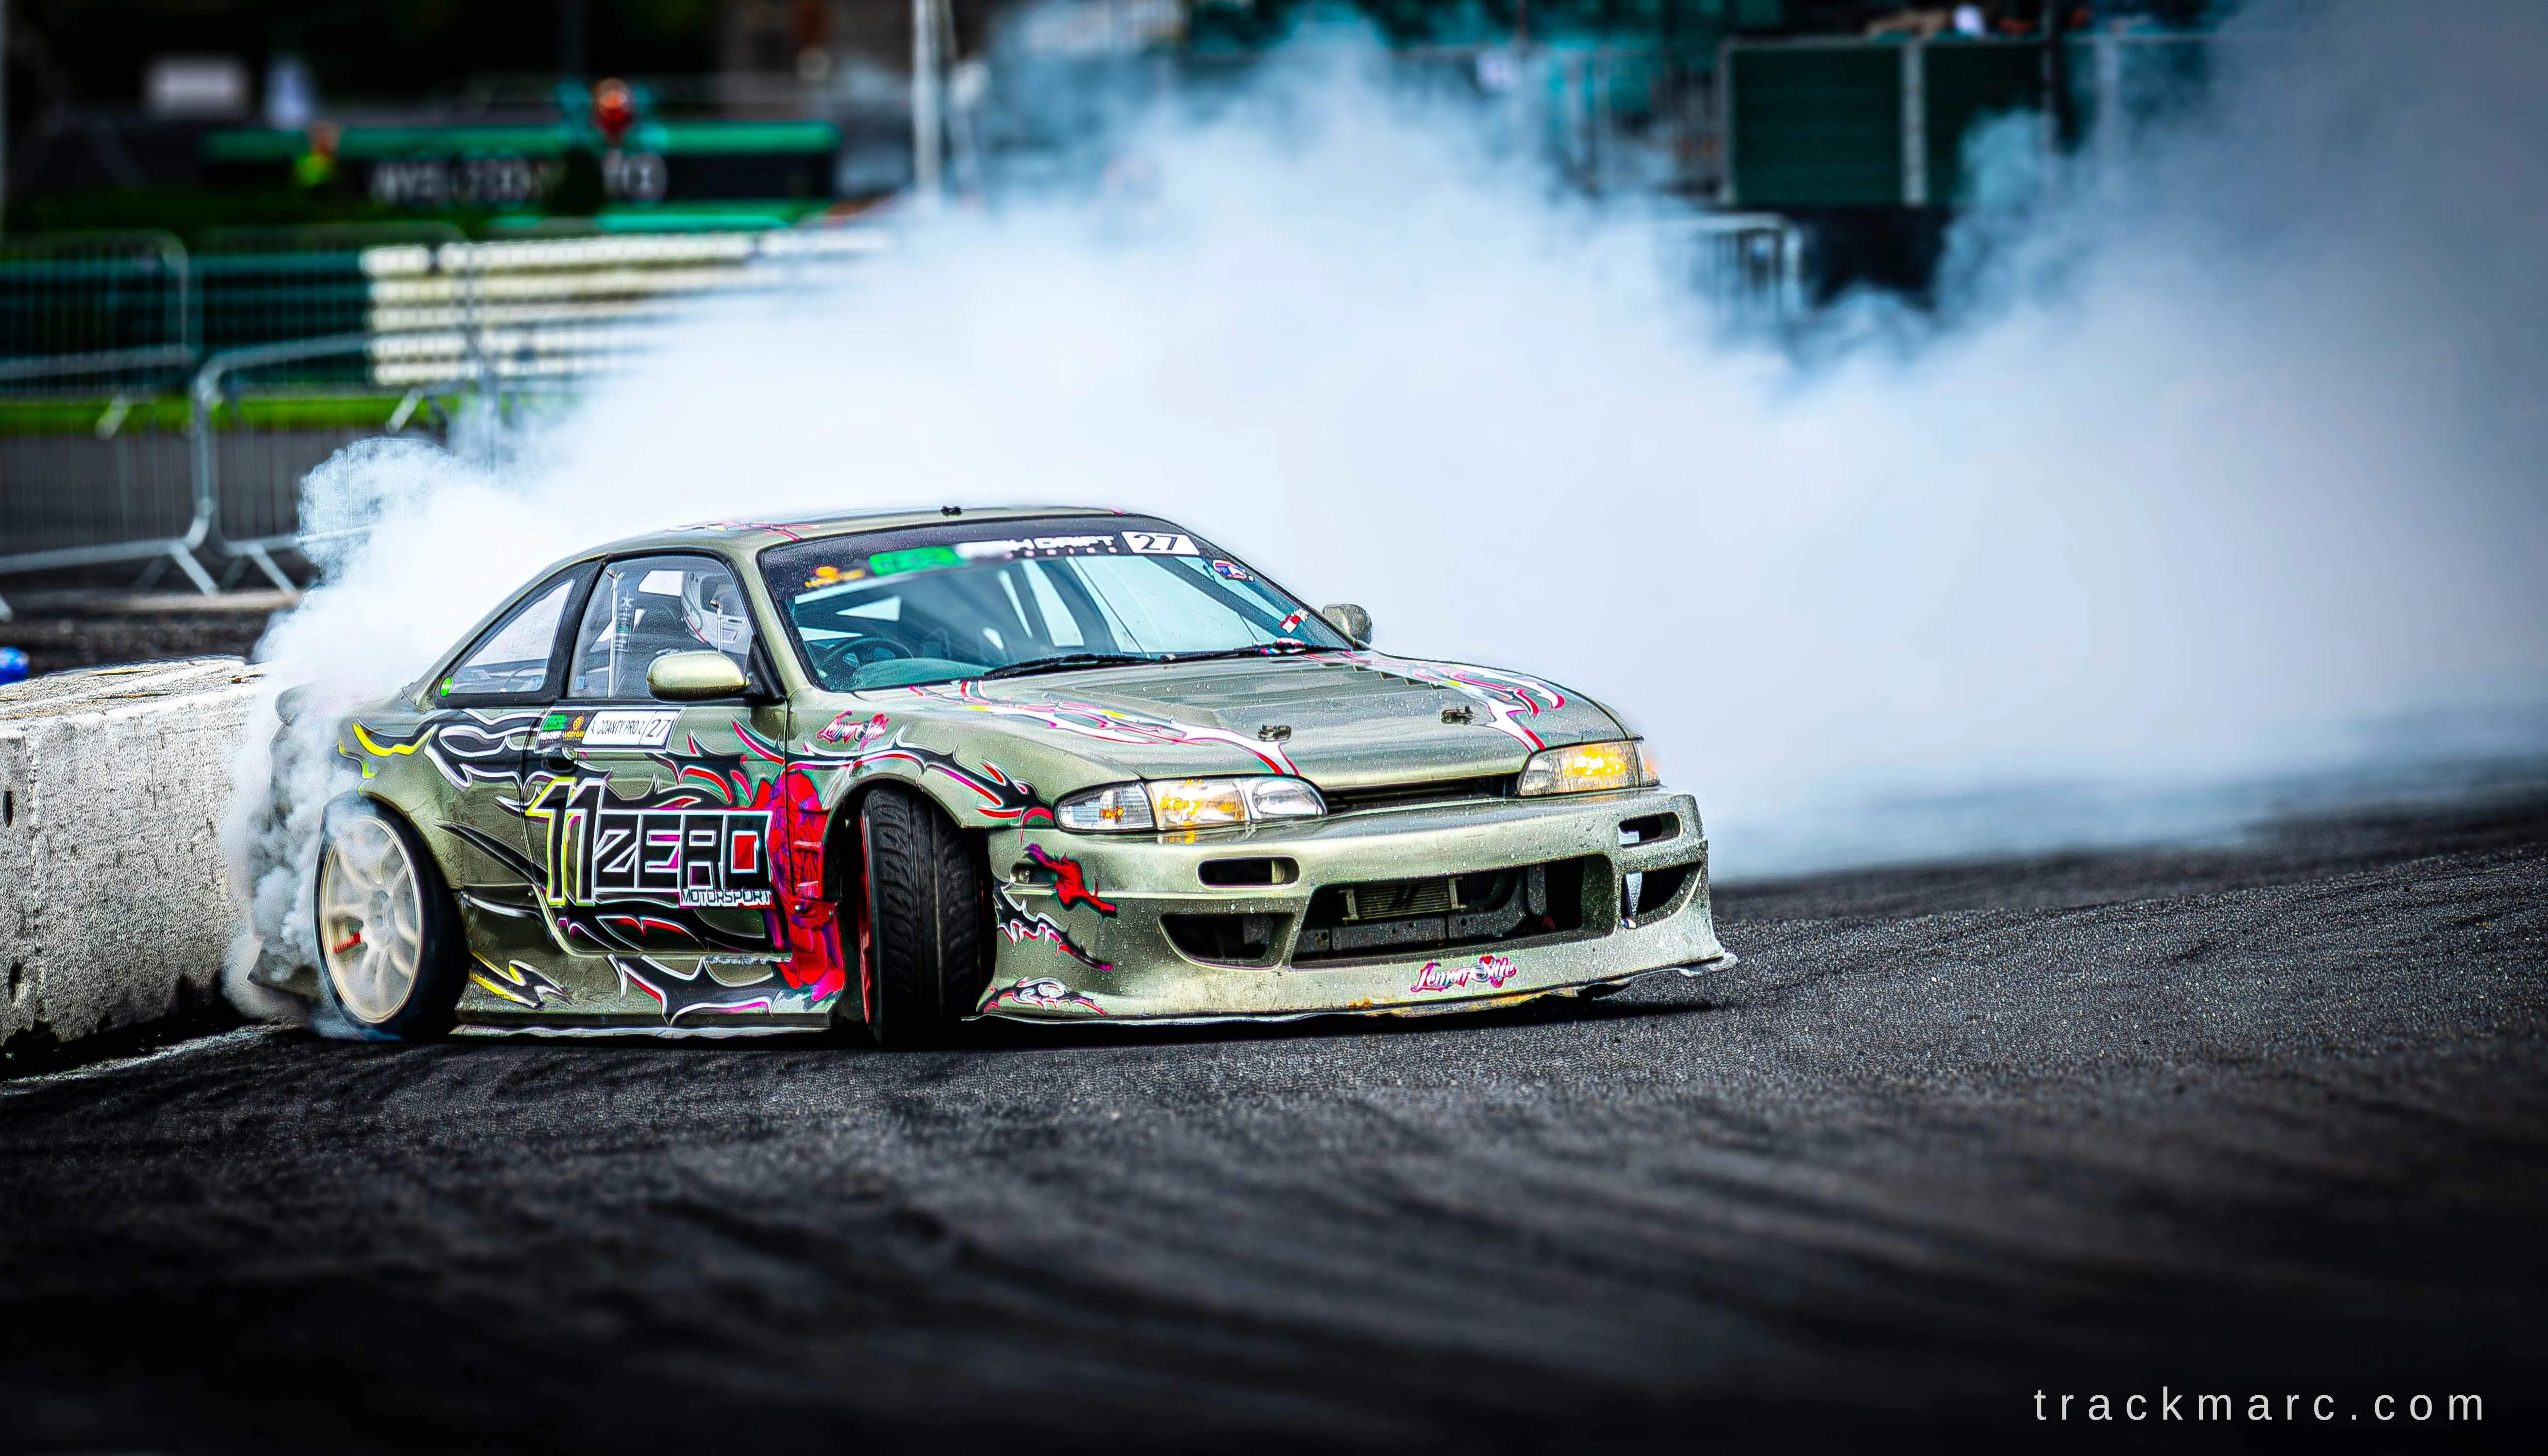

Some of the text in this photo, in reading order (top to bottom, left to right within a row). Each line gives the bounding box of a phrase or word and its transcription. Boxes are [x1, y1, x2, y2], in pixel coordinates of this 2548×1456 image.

[1133, 534, 1178, 551] 27
[624, 720, 639, 735] PRO
[645, 719, 672, 737] 27
[680, 888, 771, 906] MOTORSPORT
[1410, 960, 1471, 992] Lemon
